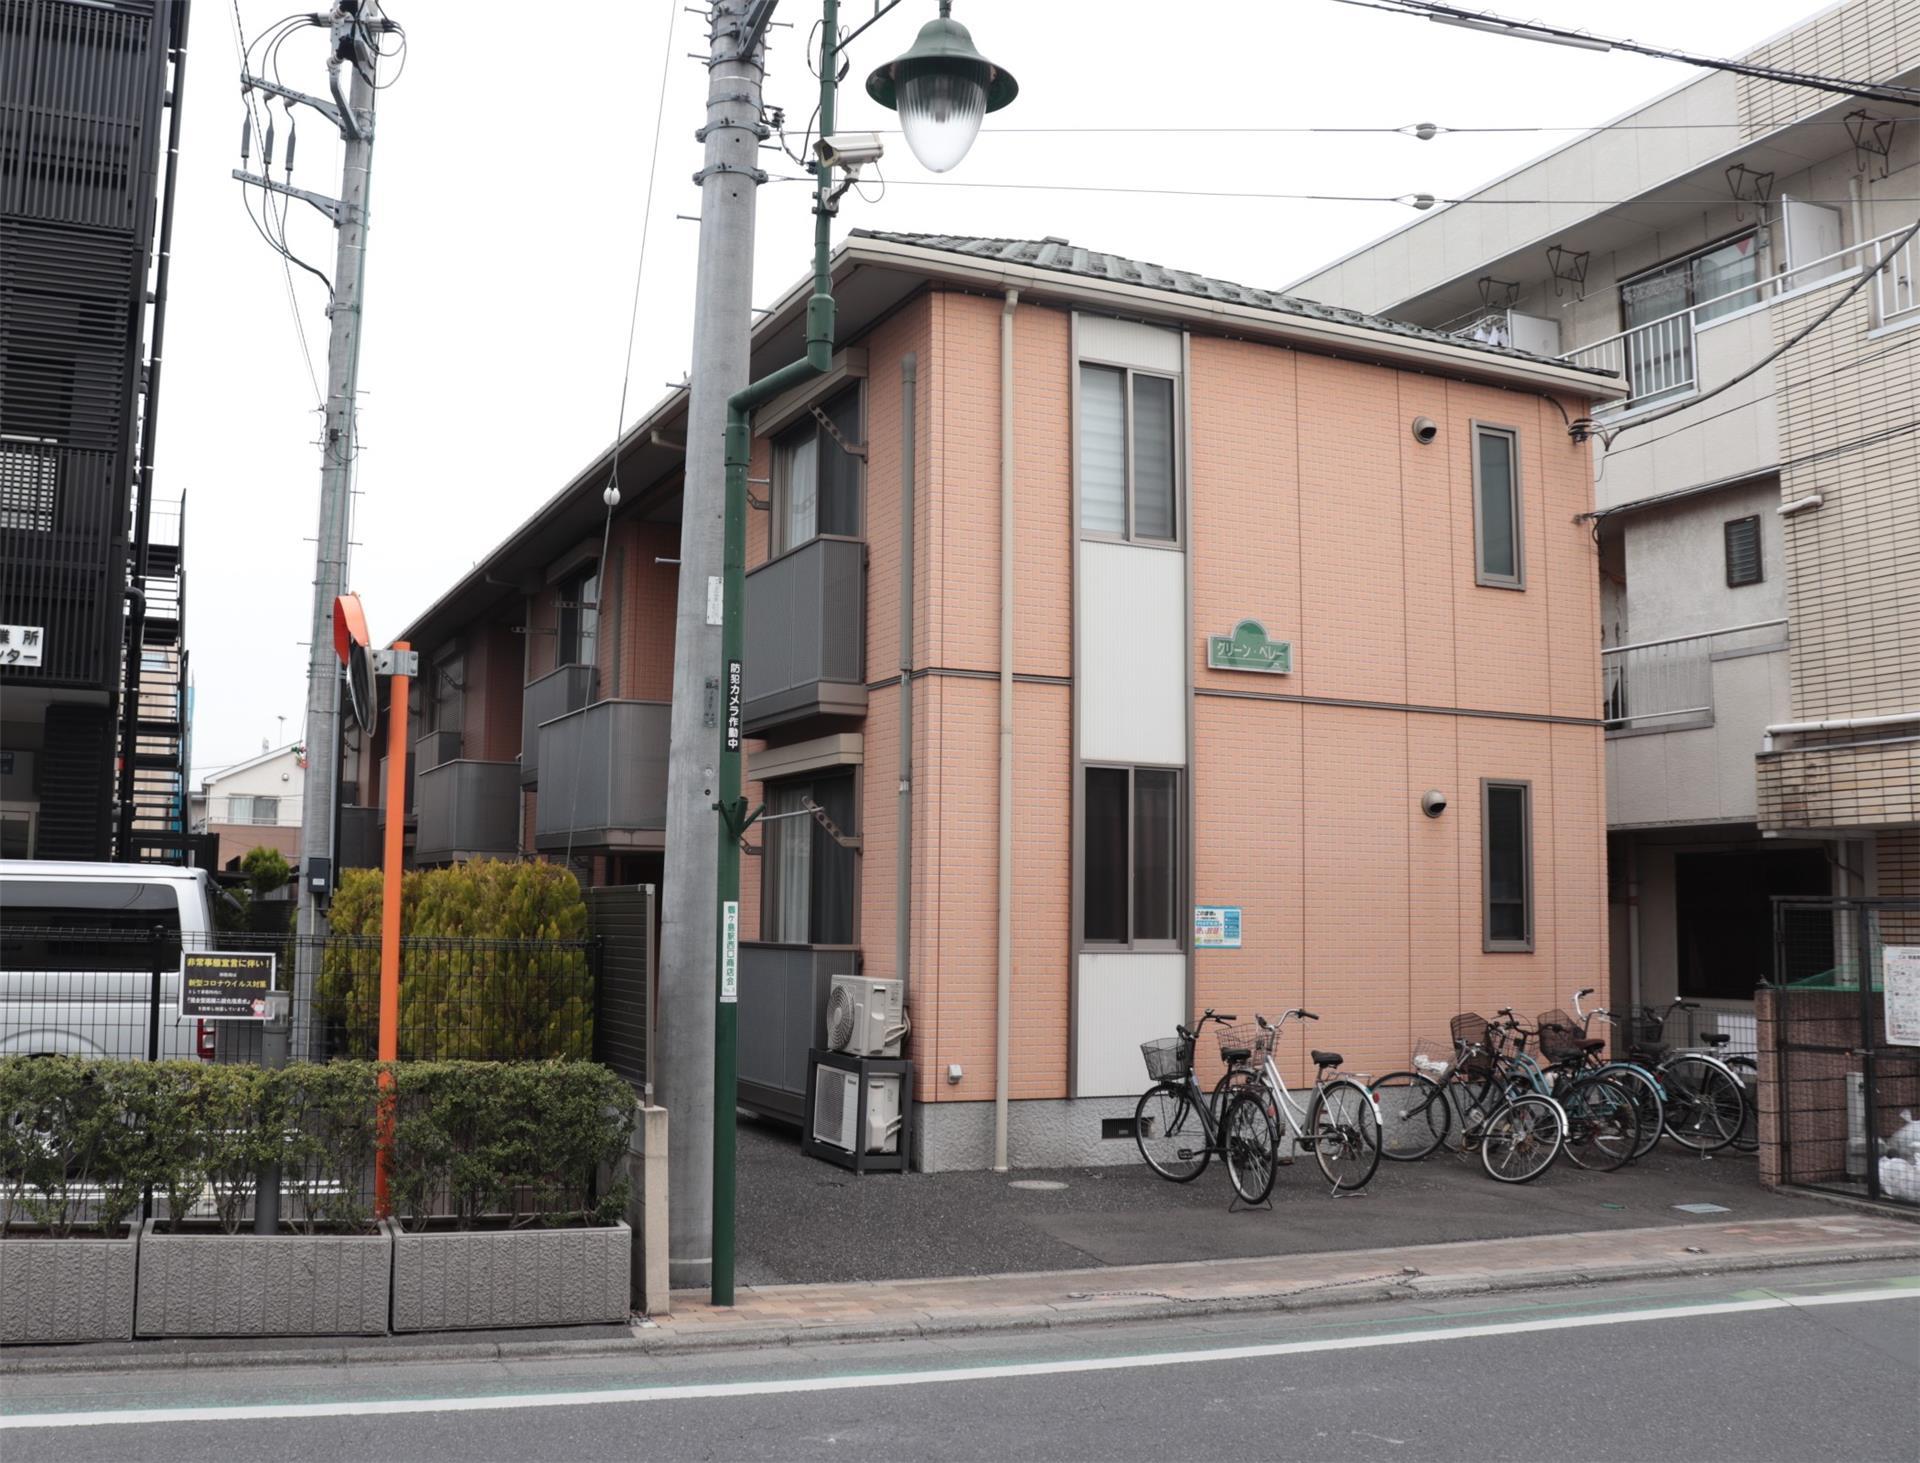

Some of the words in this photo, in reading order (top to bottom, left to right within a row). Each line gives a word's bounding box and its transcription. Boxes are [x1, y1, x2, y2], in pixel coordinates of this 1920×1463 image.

[728, 662, 741, 749] 防犯カメラ作動中
[188, 978, 267, 988] 新型コロナウイルス対策
